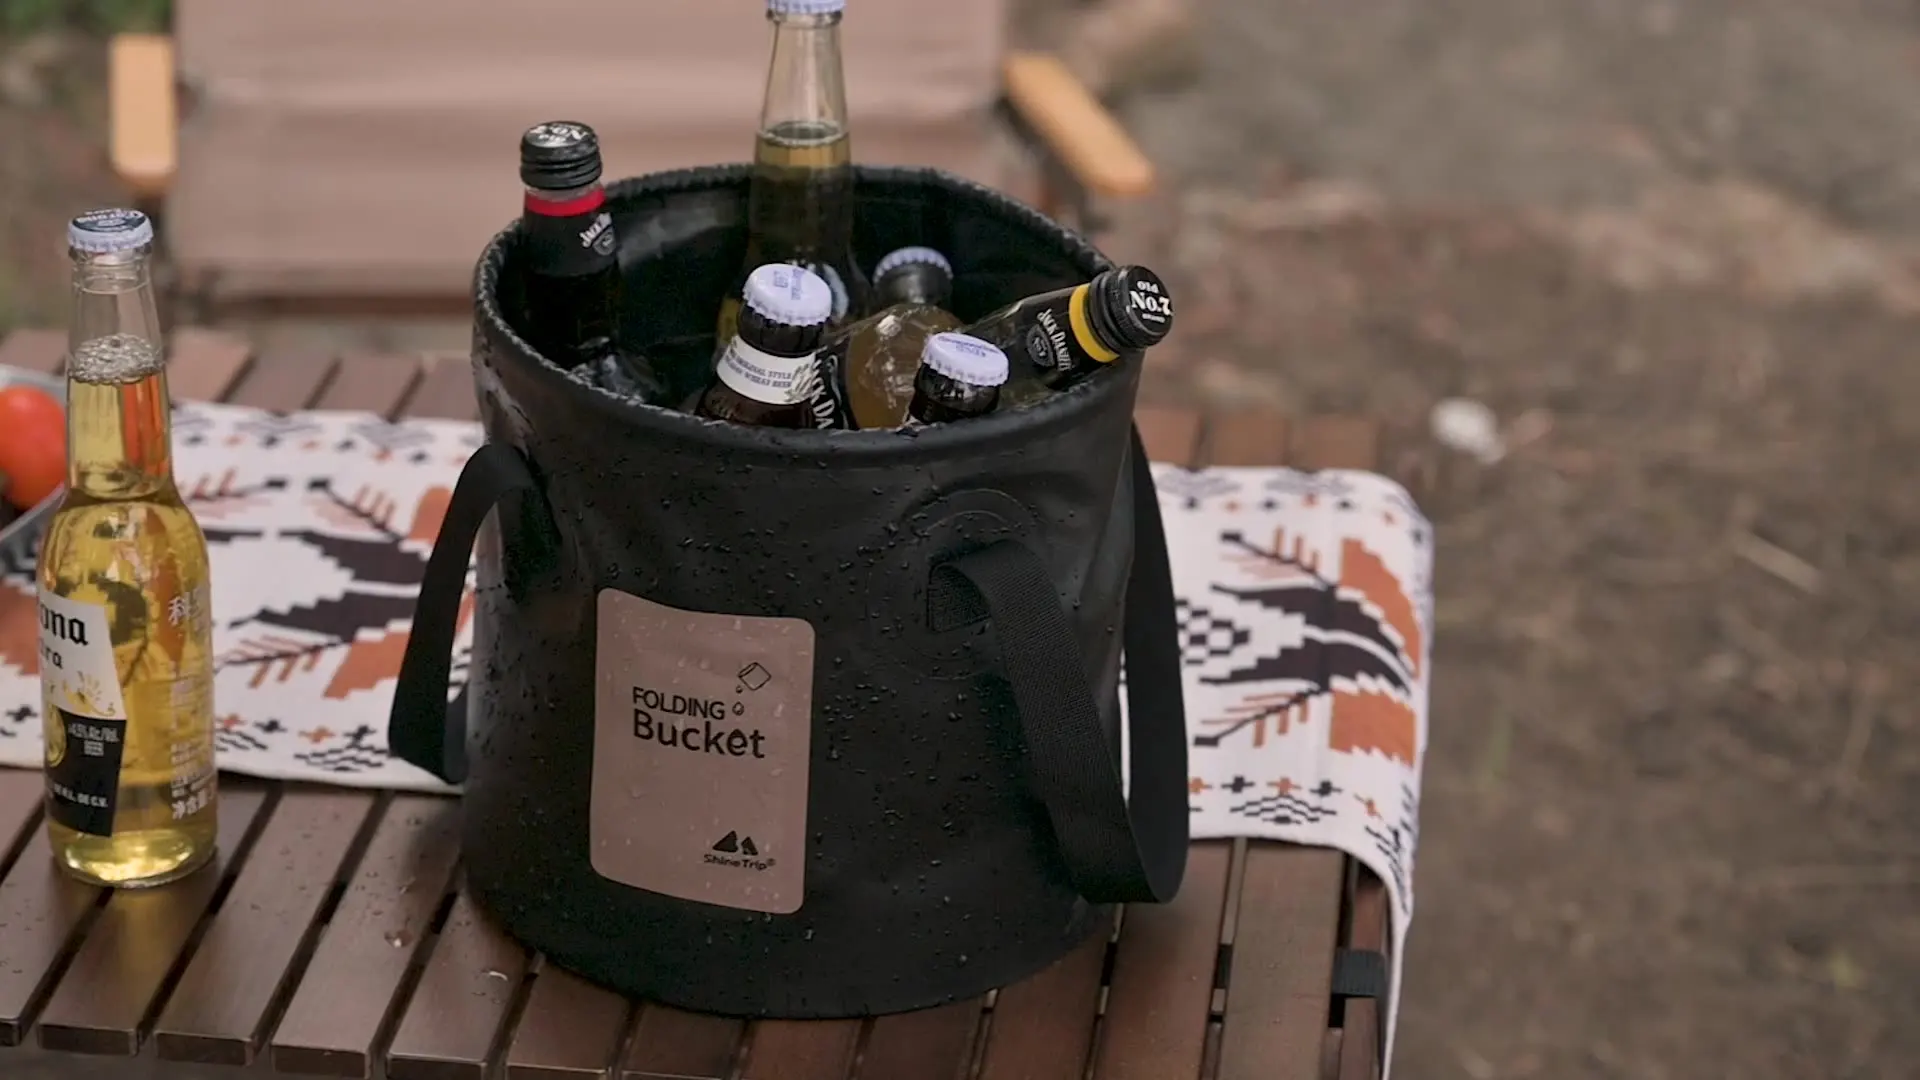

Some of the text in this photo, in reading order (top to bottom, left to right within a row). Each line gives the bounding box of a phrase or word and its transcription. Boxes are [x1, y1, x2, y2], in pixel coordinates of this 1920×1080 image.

[1129, 290, 1171, 316] No.7
[632, 686, 726, 721] FOLDING
[633, 708, 766, 759] Bucket
